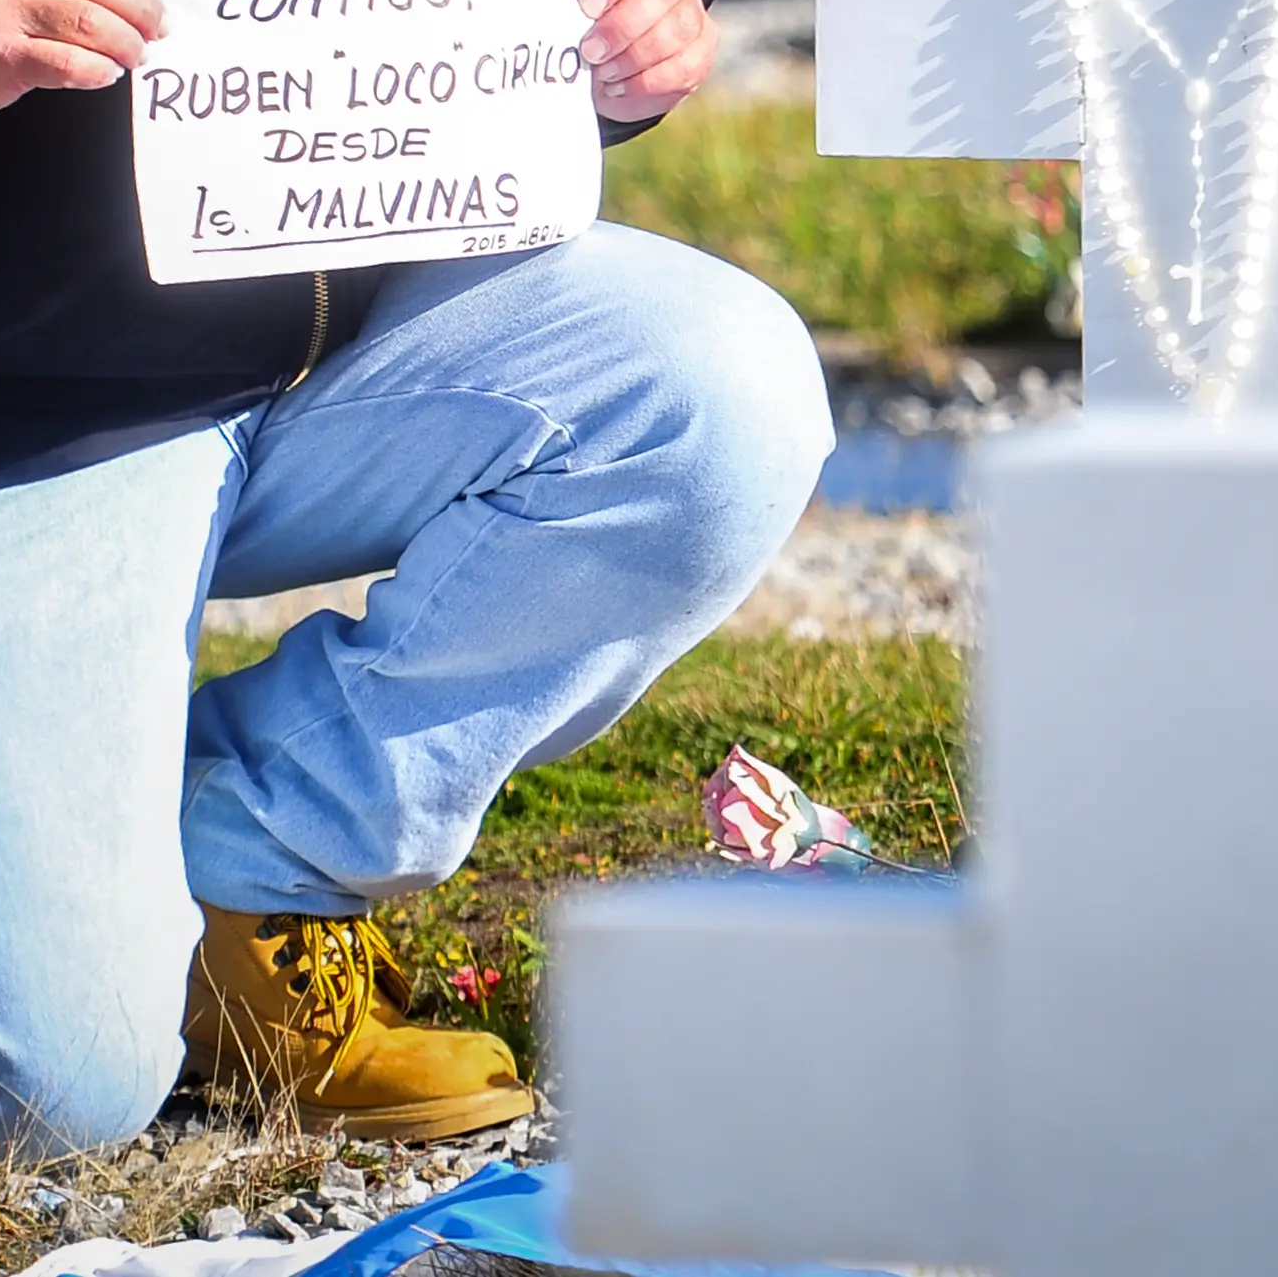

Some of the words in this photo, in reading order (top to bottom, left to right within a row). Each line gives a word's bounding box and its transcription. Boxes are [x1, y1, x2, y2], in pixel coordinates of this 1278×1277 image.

[142, 66, 313, 122] RUBEN
[263, 128, 431, 163] DESDE
[277, 174, 520, 232] MALVINAS
[462, 234, 506, 253] 2015
